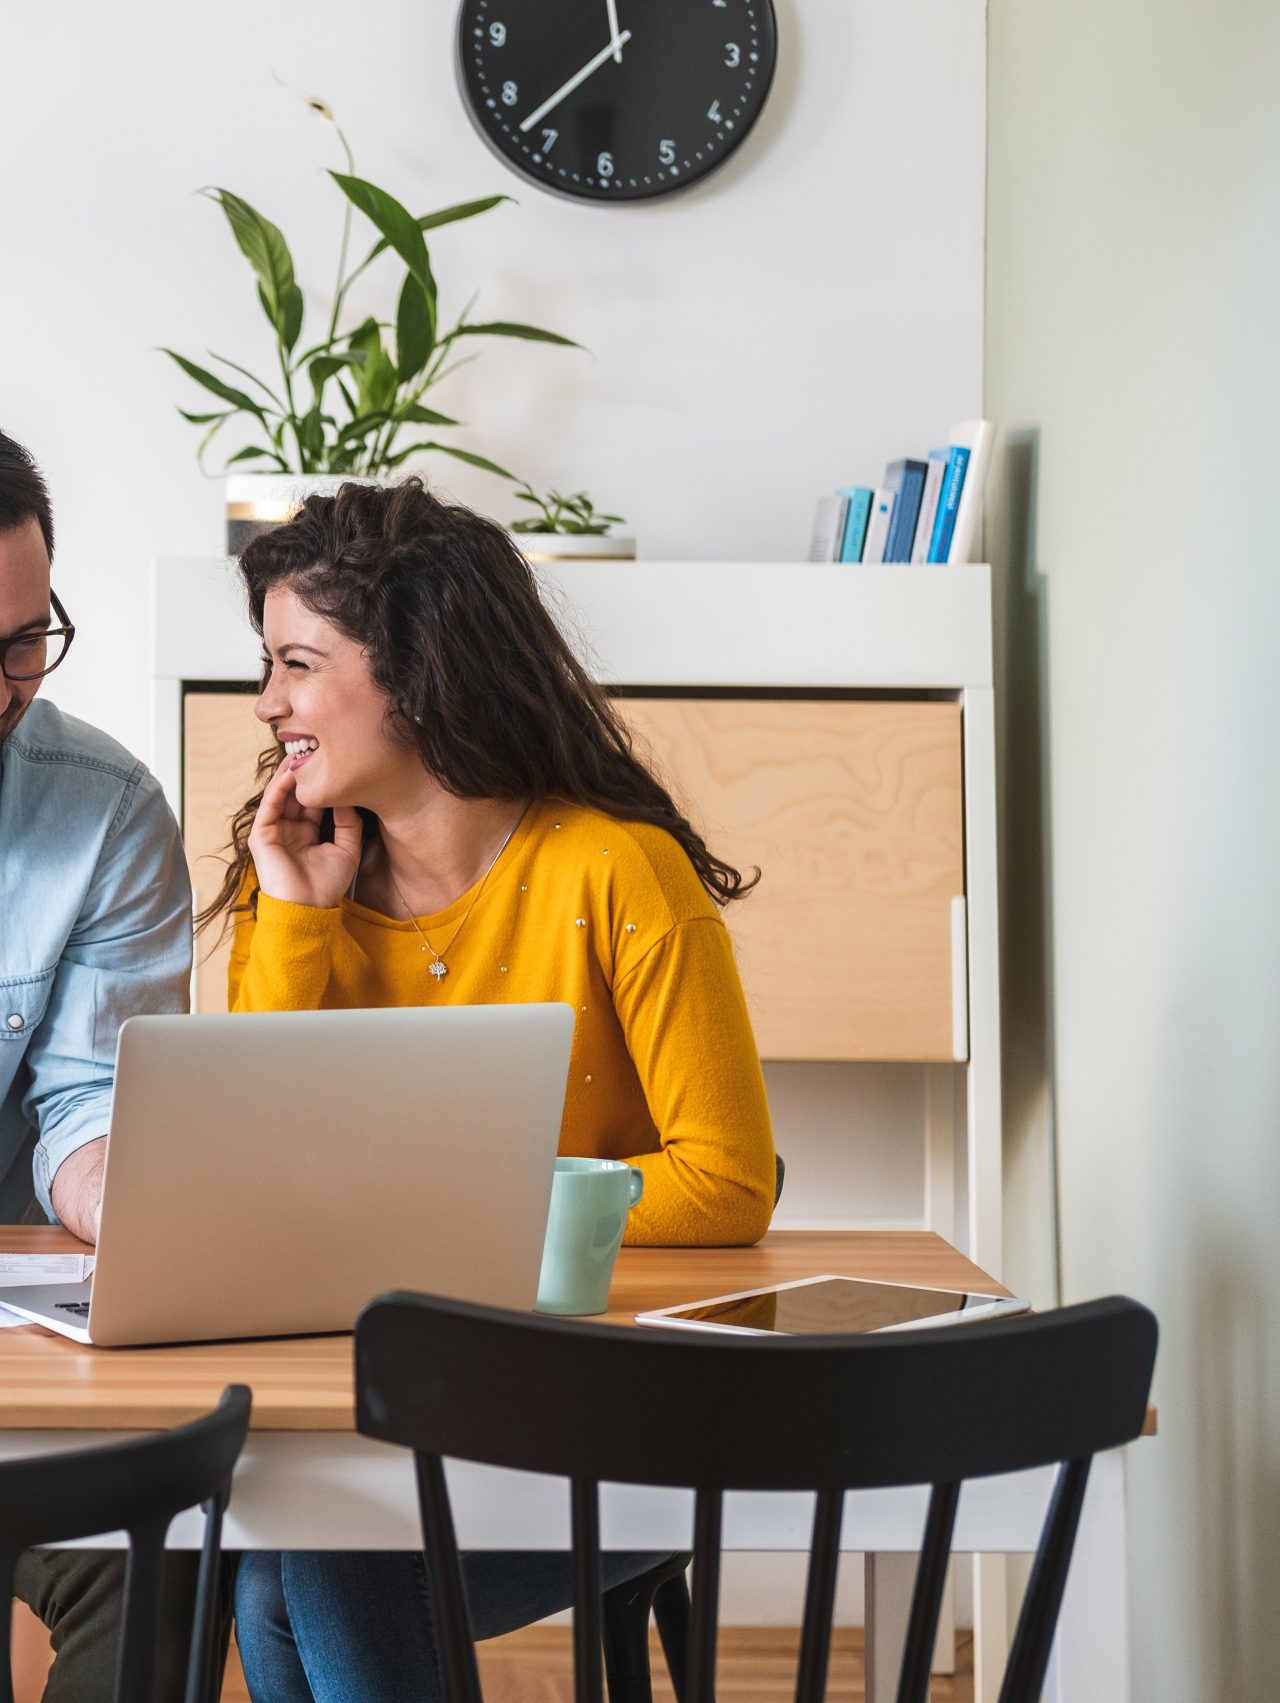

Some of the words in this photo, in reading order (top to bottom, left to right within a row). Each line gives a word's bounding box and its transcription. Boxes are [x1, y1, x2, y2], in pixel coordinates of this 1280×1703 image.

[489, 22, 507, 47] 9
[724, 43, 741, 68] 3
[501, 81, 518, 106] 8
[707, 99, 722, 124] 4
[541, 129, 559, 153] 7
[659, 140, 676, 165] 5
[597, 152, 614, 177] 6
